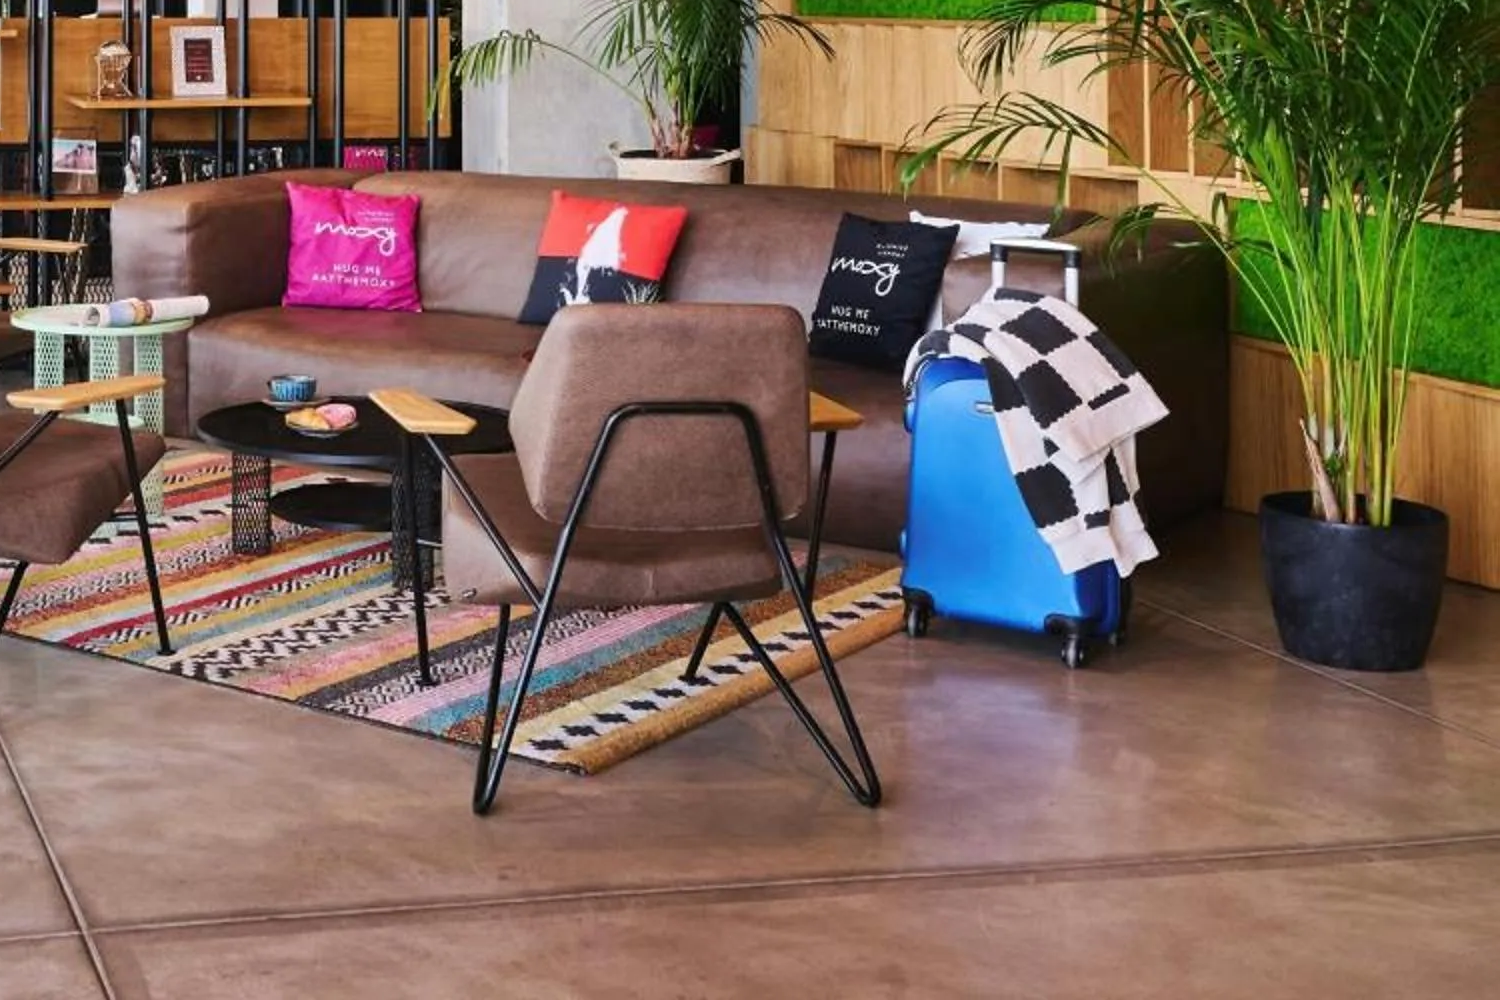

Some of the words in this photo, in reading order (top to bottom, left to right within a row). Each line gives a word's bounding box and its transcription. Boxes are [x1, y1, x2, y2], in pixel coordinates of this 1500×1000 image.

[332, 263, 360, 275] HUG
[365, 264, 382, 277] ME
[831, 303, 853, 317] HUG
[855, 307, 871, 320] ME
